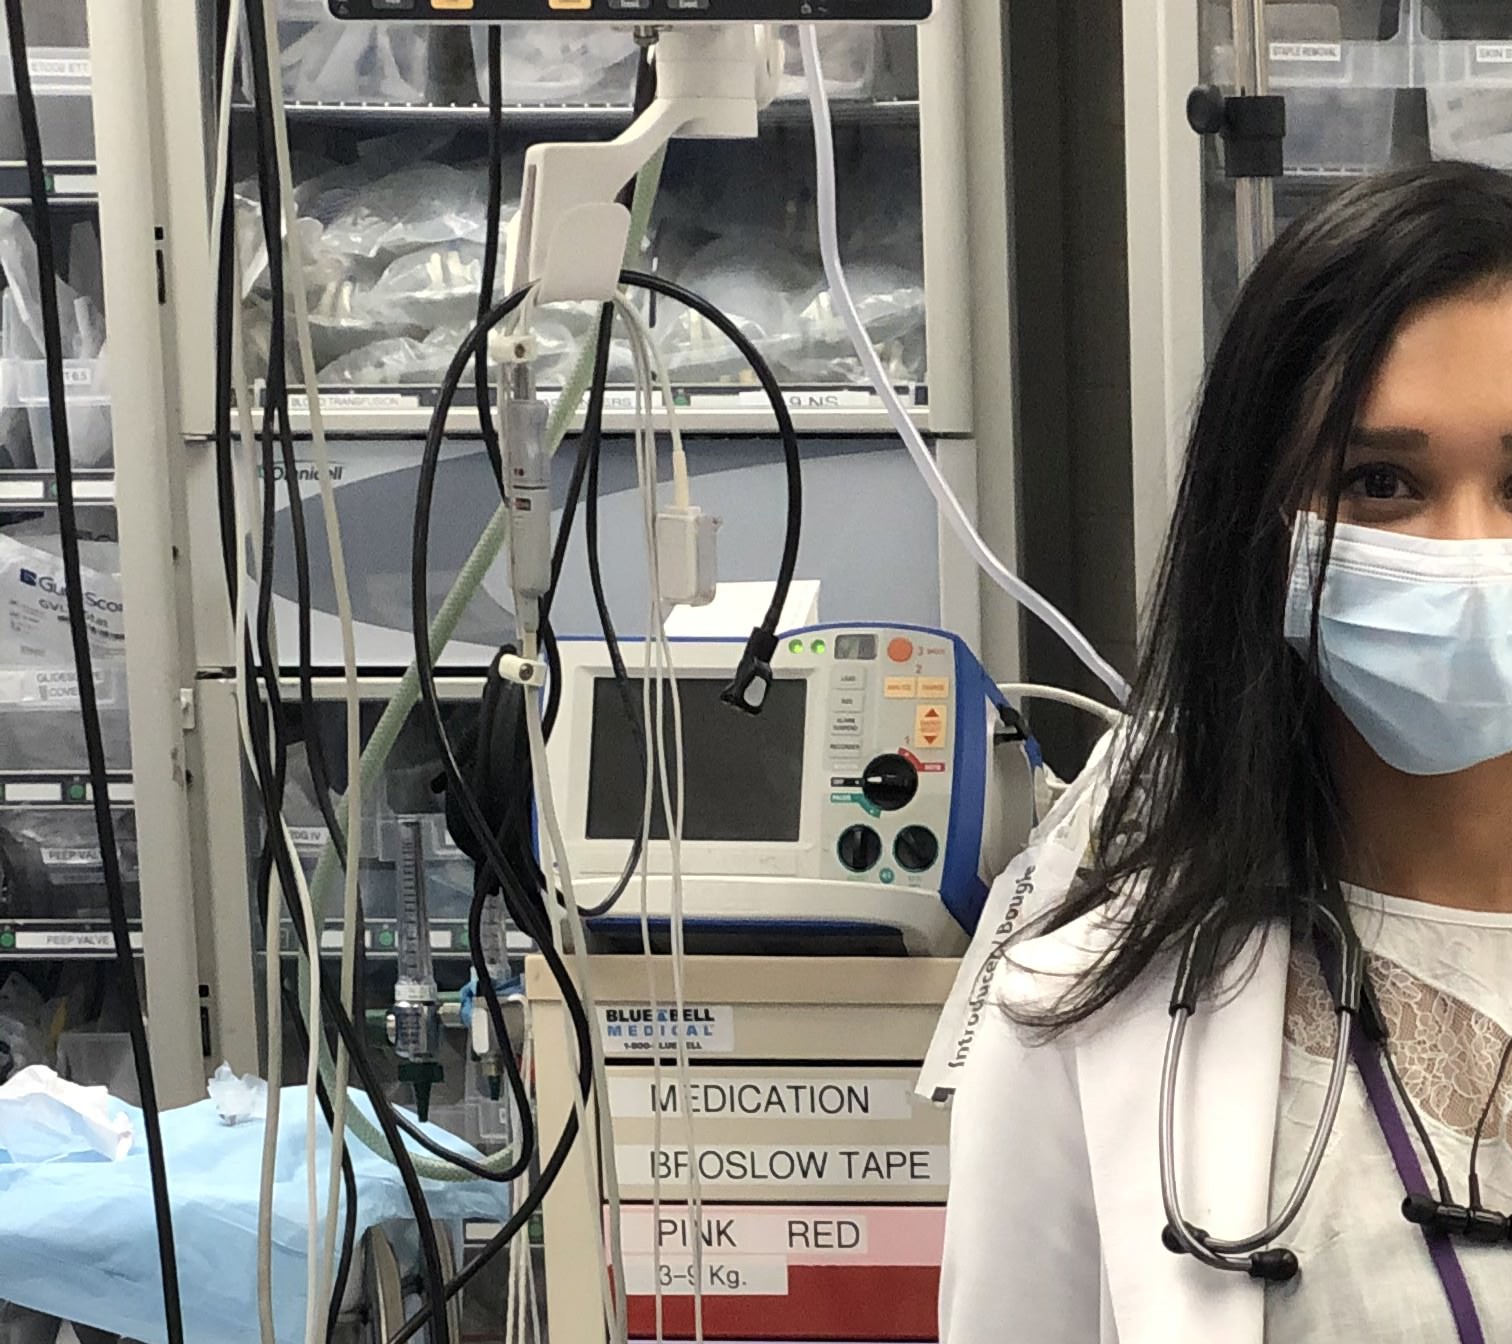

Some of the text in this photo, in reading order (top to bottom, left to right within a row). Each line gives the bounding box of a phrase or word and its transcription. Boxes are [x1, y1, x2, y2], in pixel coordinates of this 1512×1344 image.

[1478, 46, 1502, 59] SKIN
[47, 935, 110, 945] PEEP VALVE
[605, 1009, 652, 1023] BLUE
[623, 1041, 703, 1050] 1-800-LUEELL
[650, 1083, 870, 1114] MEDICATION
[838, 1151, 931, 1180] TAPE
[658, 1218, 860, 1249] PINK RED
[709, 1265, 747, 1289] Kg.
